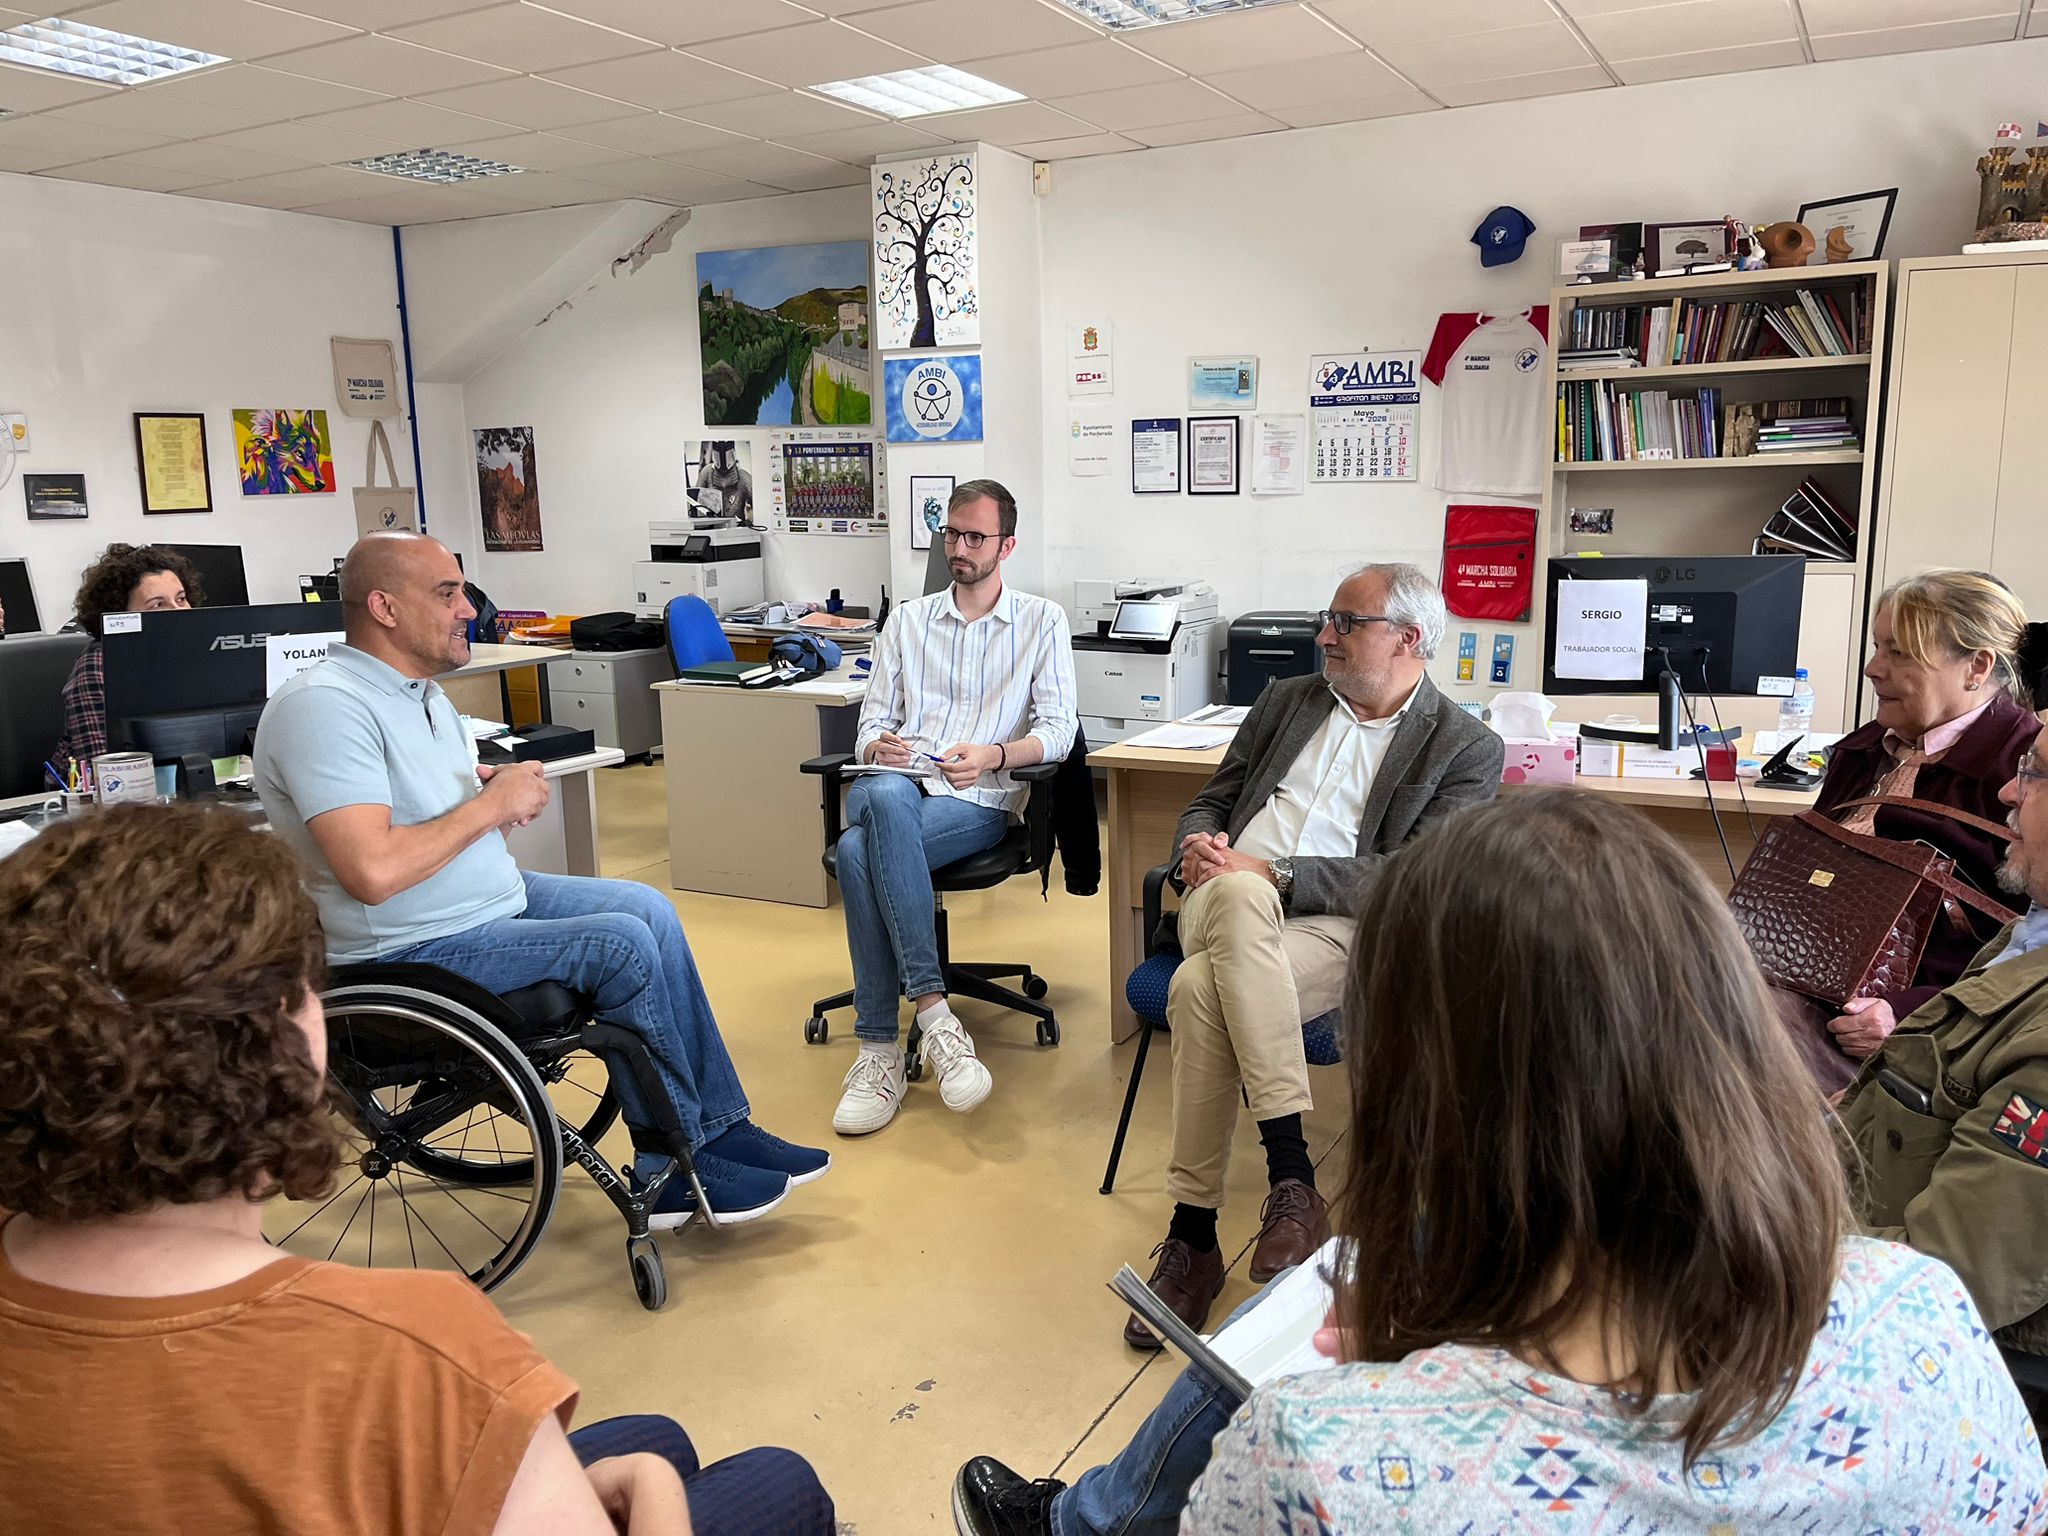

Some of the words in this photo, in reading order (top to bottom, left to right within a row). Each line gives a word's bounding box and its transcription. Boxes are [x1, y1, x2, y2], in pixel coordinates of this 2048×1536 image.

[918, 367, 946, 381] AMBI
[1345, 360, 1414, 384] AMBI
[1353, 410, 1375, 418] Mayo
[1398, 437, 1406, 445] 10
[1317, 449, 1324, 457] 11
[1330, 449, 1337, 457] 12
[1343, 448, 1351, 456] 13
[1356, 448, 1364, 456] 14
[1370, 448, 1378, 456] 15
[1384, 447, 1392, 456] 16
[1398, 447, 1405, 455] 17
[1317, 459, 1324, 467] 18
[1329, 459, 1337, 467] 19
[1342, 458, 1351, 466] 20
[1356, 458, 1364, 466] 21
[1369, 458, 1378, 466] 22
[1397, 457, 1406, 465] 24
[1316, 469, 1325, 477] 25
[1329, 469, 1337, 477] 26
[1342, 468, 1350, 477] 27
[1356, 468, 1364, 476] 28
[1369, 468, 1378, 476] 29
[1397, 468, 1405, 476] 31
[486, 531, 500, 540] LAS
[1466, 564, 1489, 576] MARCHA
[1489, 565, 1518, 577] SOLIDARIA
[1676, 568, 1696, 580] LG
[1581, 610, 1622, 620] SERGIO
[209, 632, 272, 651] ASUS
[283, 648, 328, 660] YOLAN
[1564, 645, 1611, 653] TRABAJADOR
